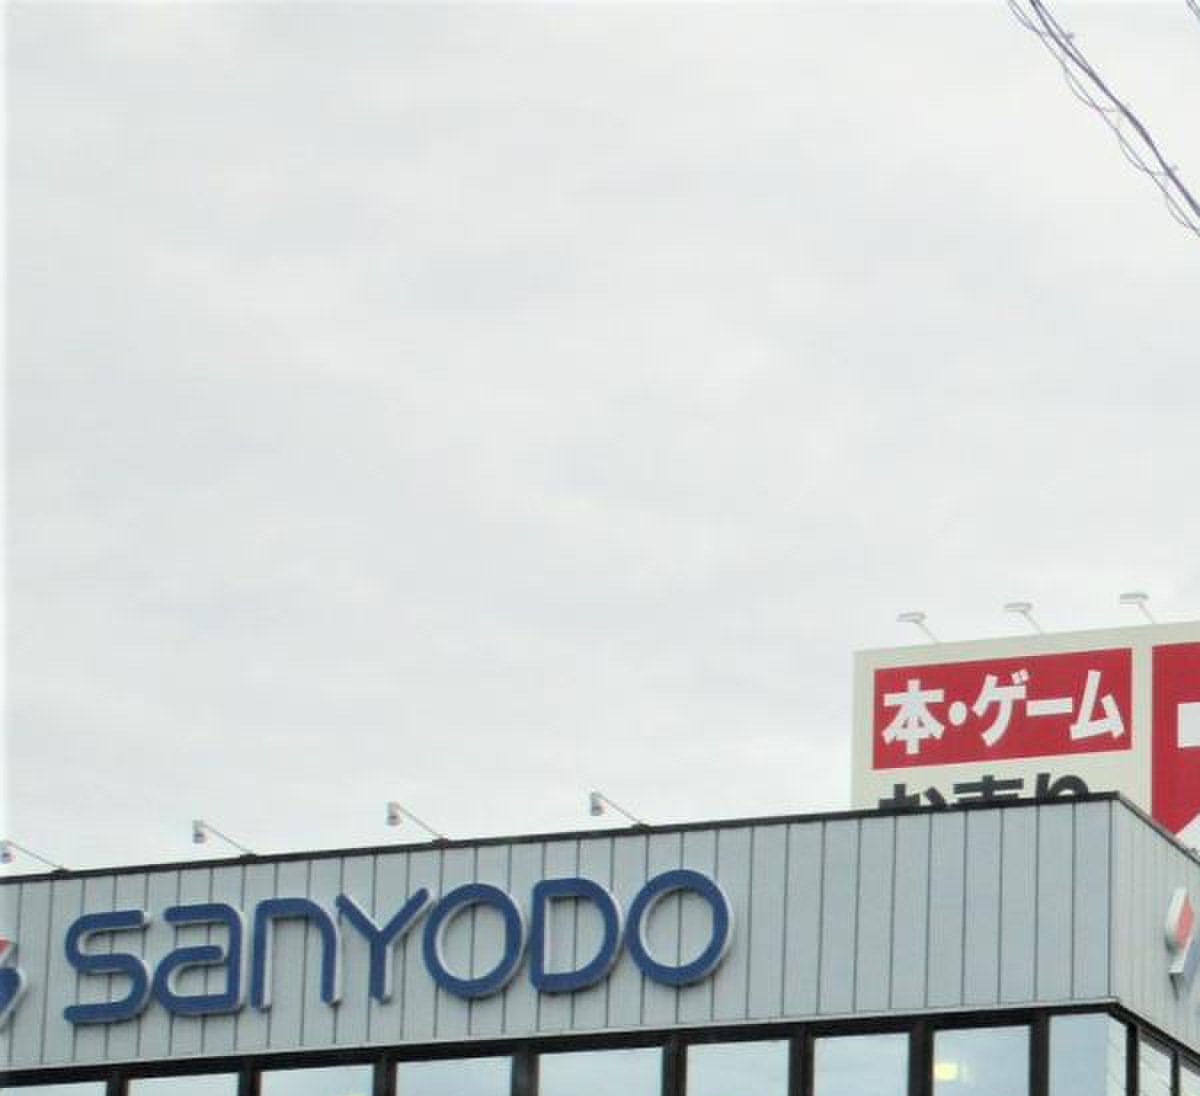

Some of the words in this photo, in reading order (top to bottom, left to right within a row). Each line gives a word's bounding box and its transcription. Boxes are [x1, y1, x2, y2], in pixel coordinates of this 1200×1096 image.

[881, 669, 1126, 755] 本・ゲーム
